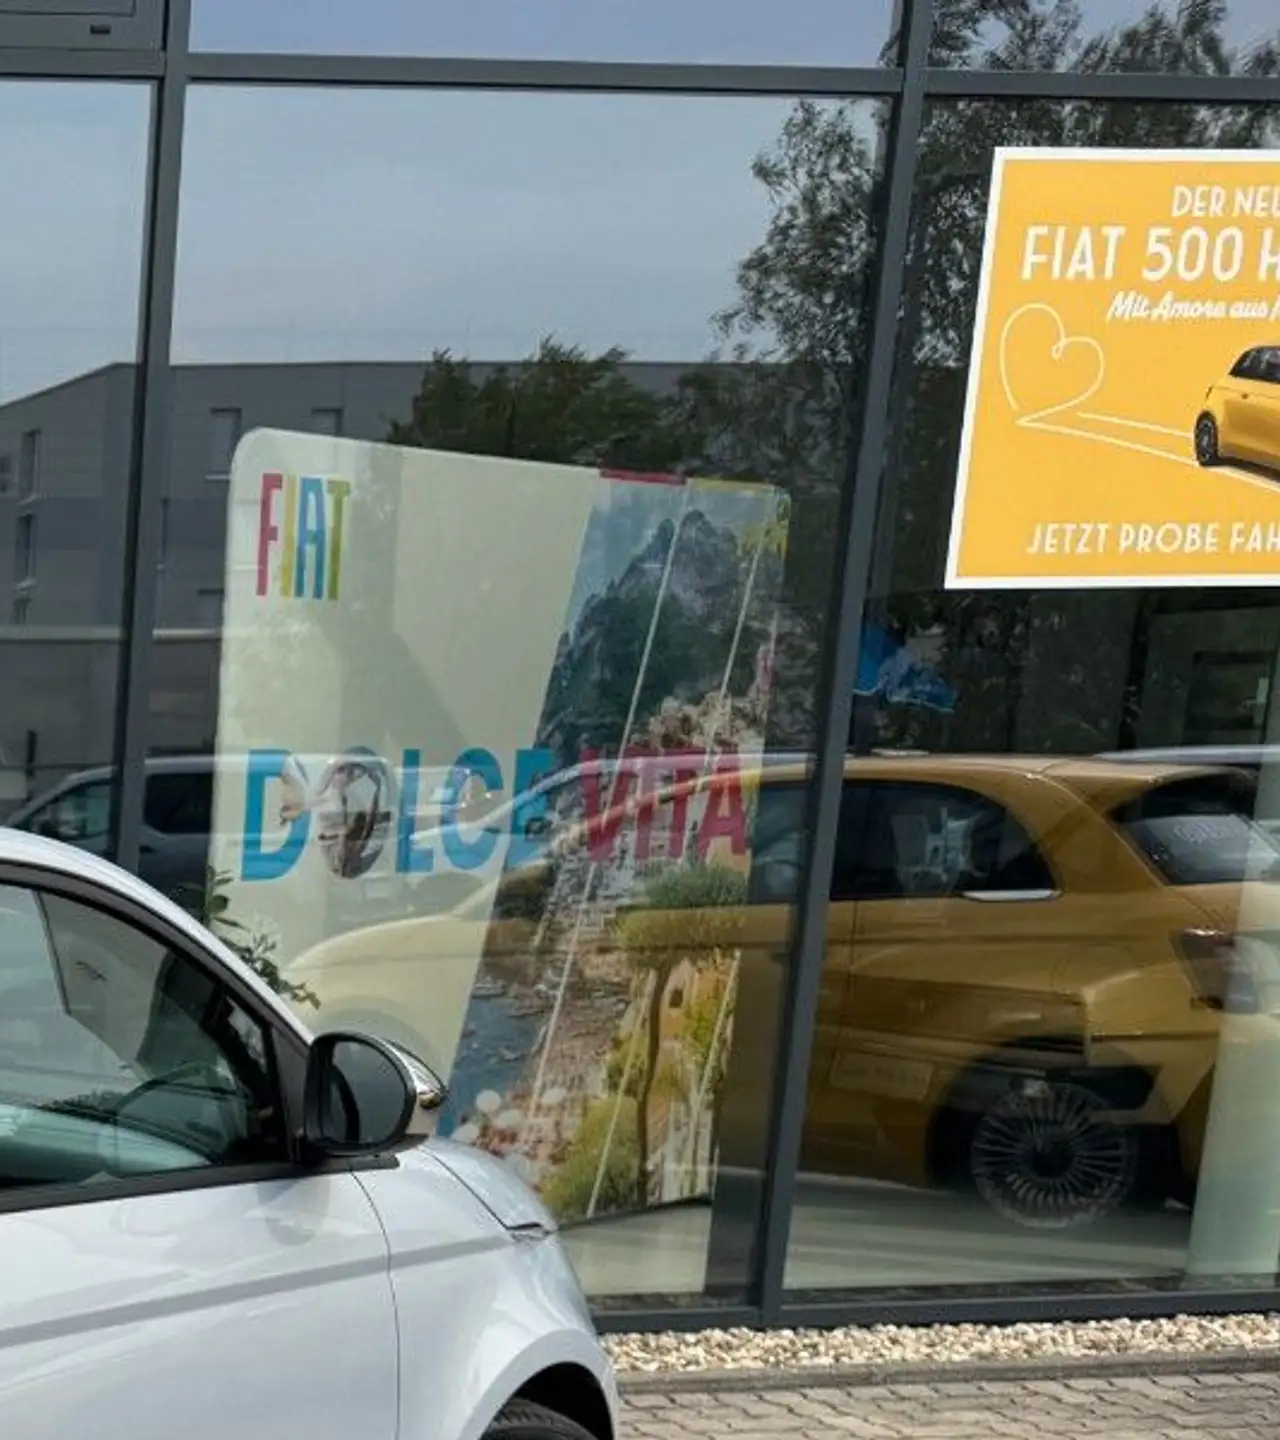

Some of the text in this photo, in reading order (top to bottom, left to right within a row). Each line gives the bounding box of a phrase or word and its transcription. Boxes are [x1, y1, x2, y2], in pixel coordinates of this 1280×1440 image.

[1171, 184, 1226, 218] DER
[1021, 225, 1126, 281] FIAT
[1141, 226, 1244, 282] 500
[255, 472, 352, 602] FIAT
[1026, 522, 1109, 554] JETZT
[1118, 522, 1220, 554] PROBE
[240, 745, 749, 882] DOLCE VITA
